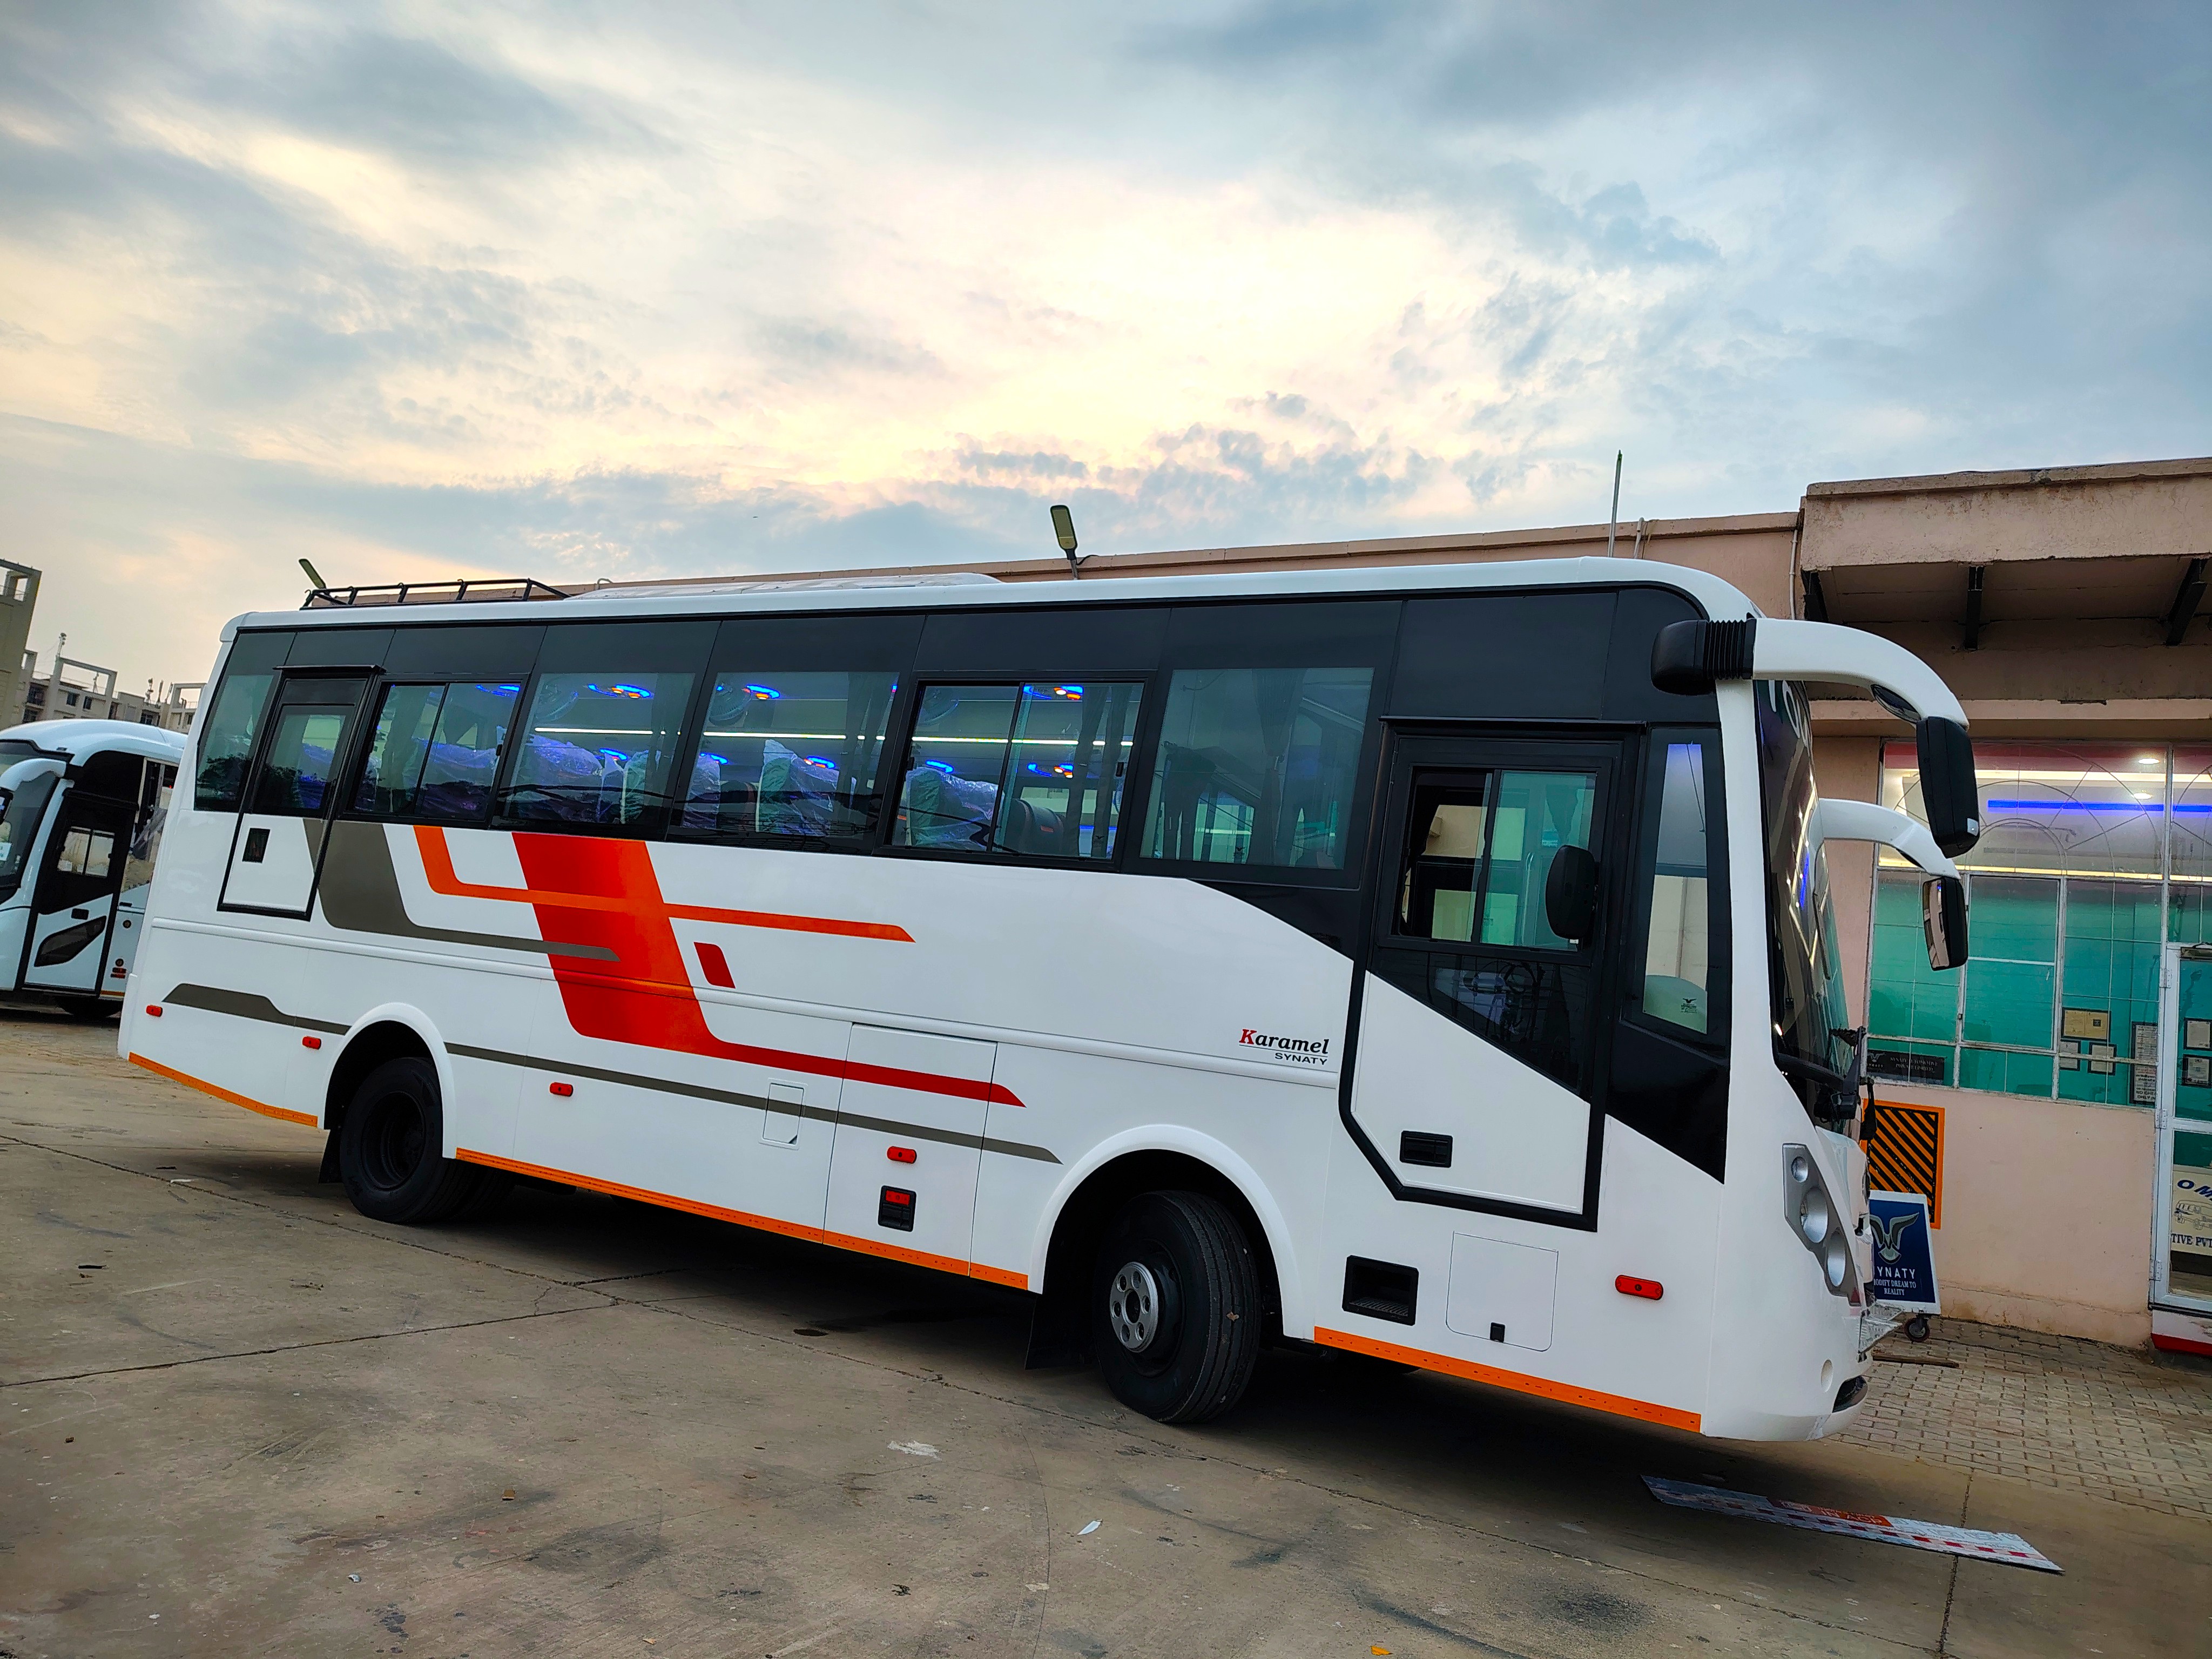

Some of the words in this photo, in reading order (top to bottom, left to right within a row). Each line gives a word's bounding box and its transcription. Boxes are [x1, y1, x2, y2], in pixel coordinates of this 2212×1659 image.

[1238, 1028, 1329, 1054] Karamel
[1274, 1053, 1327, 1065] SYNATY
[1877, 1266, 1916, 1279] YNATY
[1891, 1280, 1908, 1288] DREAM
[1884, 1287, 1905, 1296] REALITY
